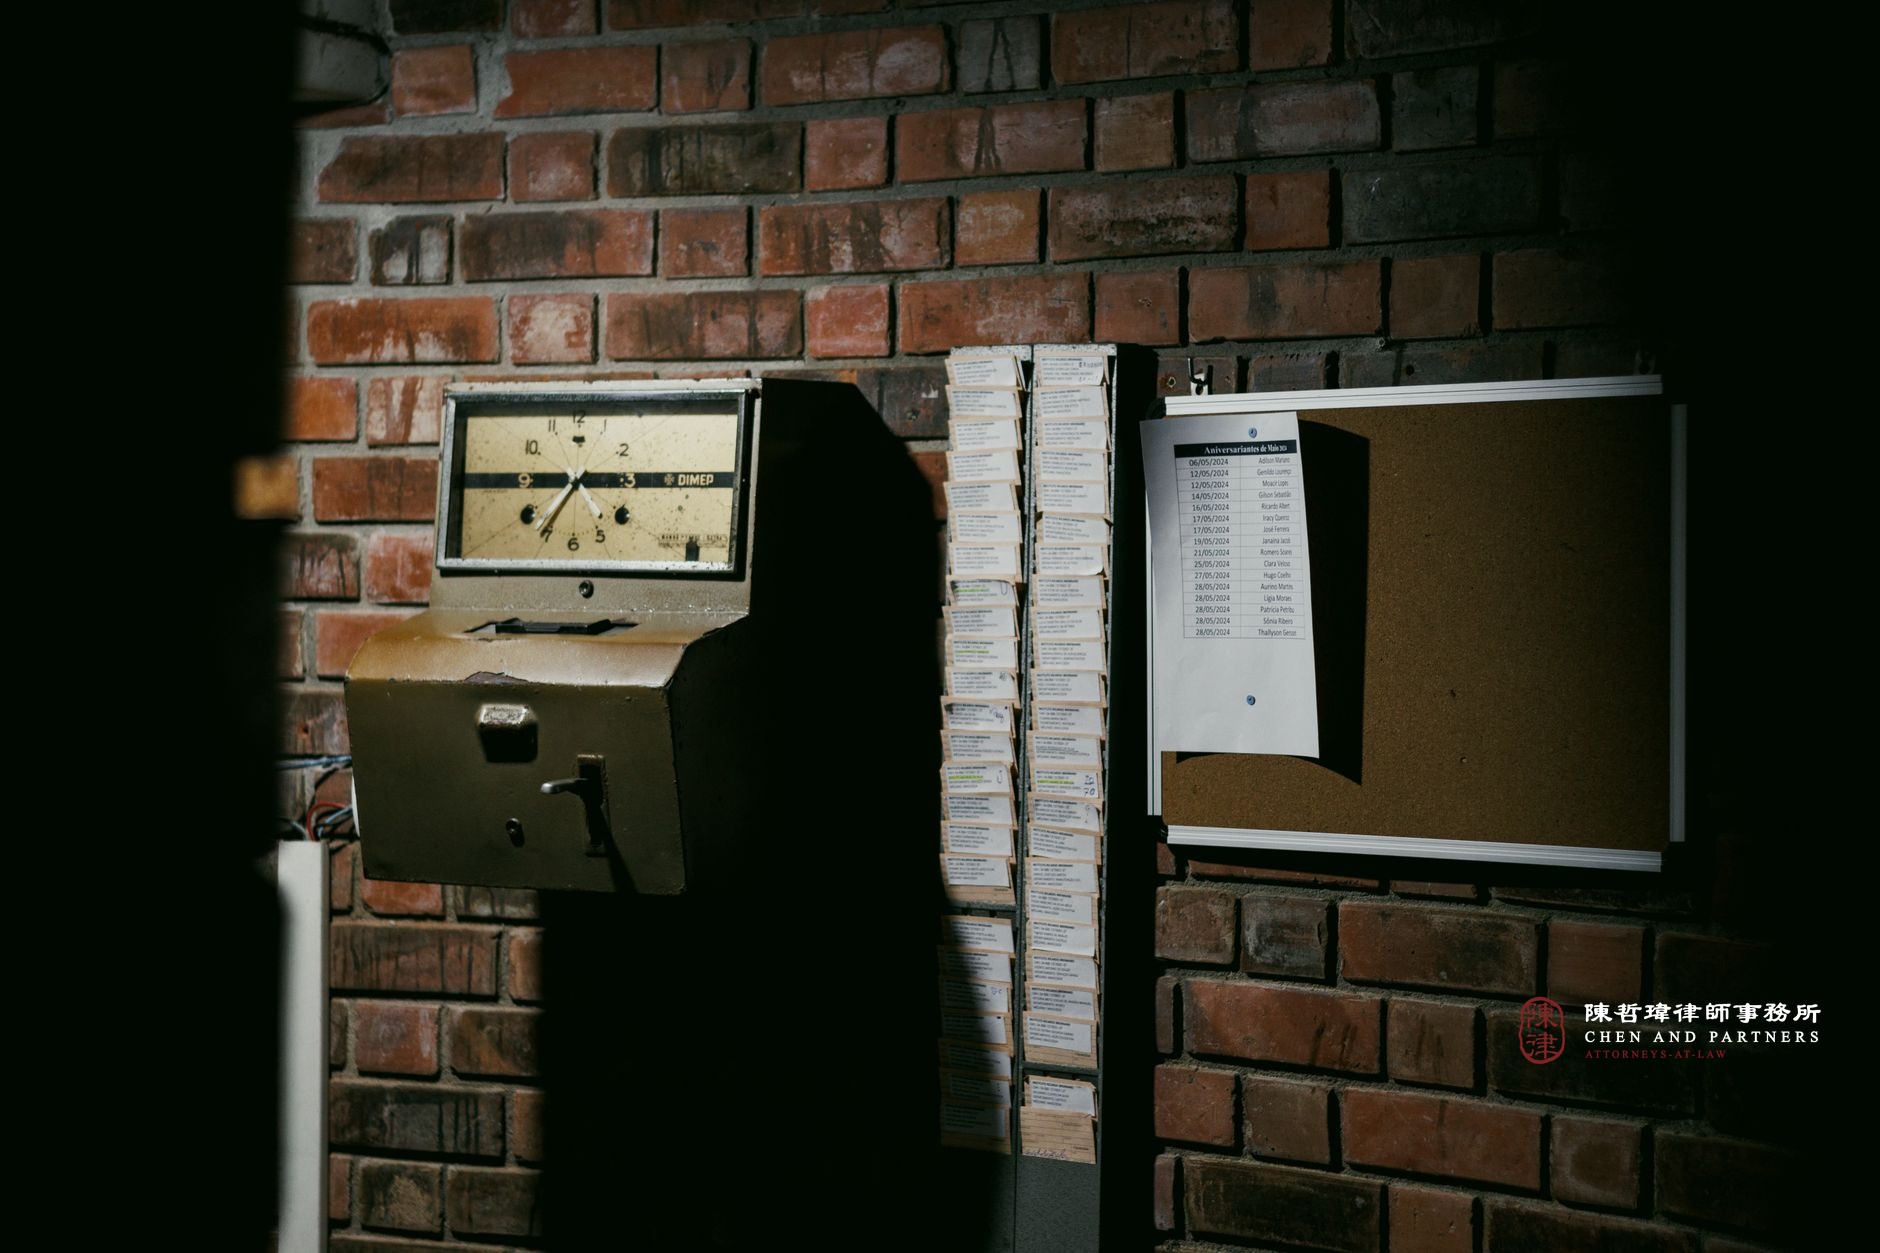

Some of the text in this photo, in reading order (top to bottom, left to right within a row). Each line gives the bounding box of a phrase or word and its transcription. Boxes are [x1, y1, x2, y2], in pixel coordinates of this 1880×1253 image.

[572, 411, 586, 424] 12
[548, 419, 556, 432] 11
[525, 440, 539, 454] 10
[618, 443, 630, 457] 2
[1204, 444, 1260, 454] Aniversariantes
[1188, 458, 1229, 467] 06/05/2024
[1190, 470, 1229, 478] 12/05/2024
[518, 474, 531, 488] 9
[624, 473, 636, 488] 3
[678, 474, 714, 487] DIMEP
[1191, 481, 1229, 489] 12/05/2024
[1192, 492, 1229, 501] 14/05/2024
[1192, 504, 1230, 512] 16/05/2024
[1192, 515, 1230, 523] 17/05/2024
[1193, 526, 1230, 534] 17/05/2024
[596, 528, 606, 544] 5
[568, 538, 580, 552] 6
[1194, 538, 1230, 546] 19/05/2024
[1194, 549, 1230, 557] 21/05/2024
